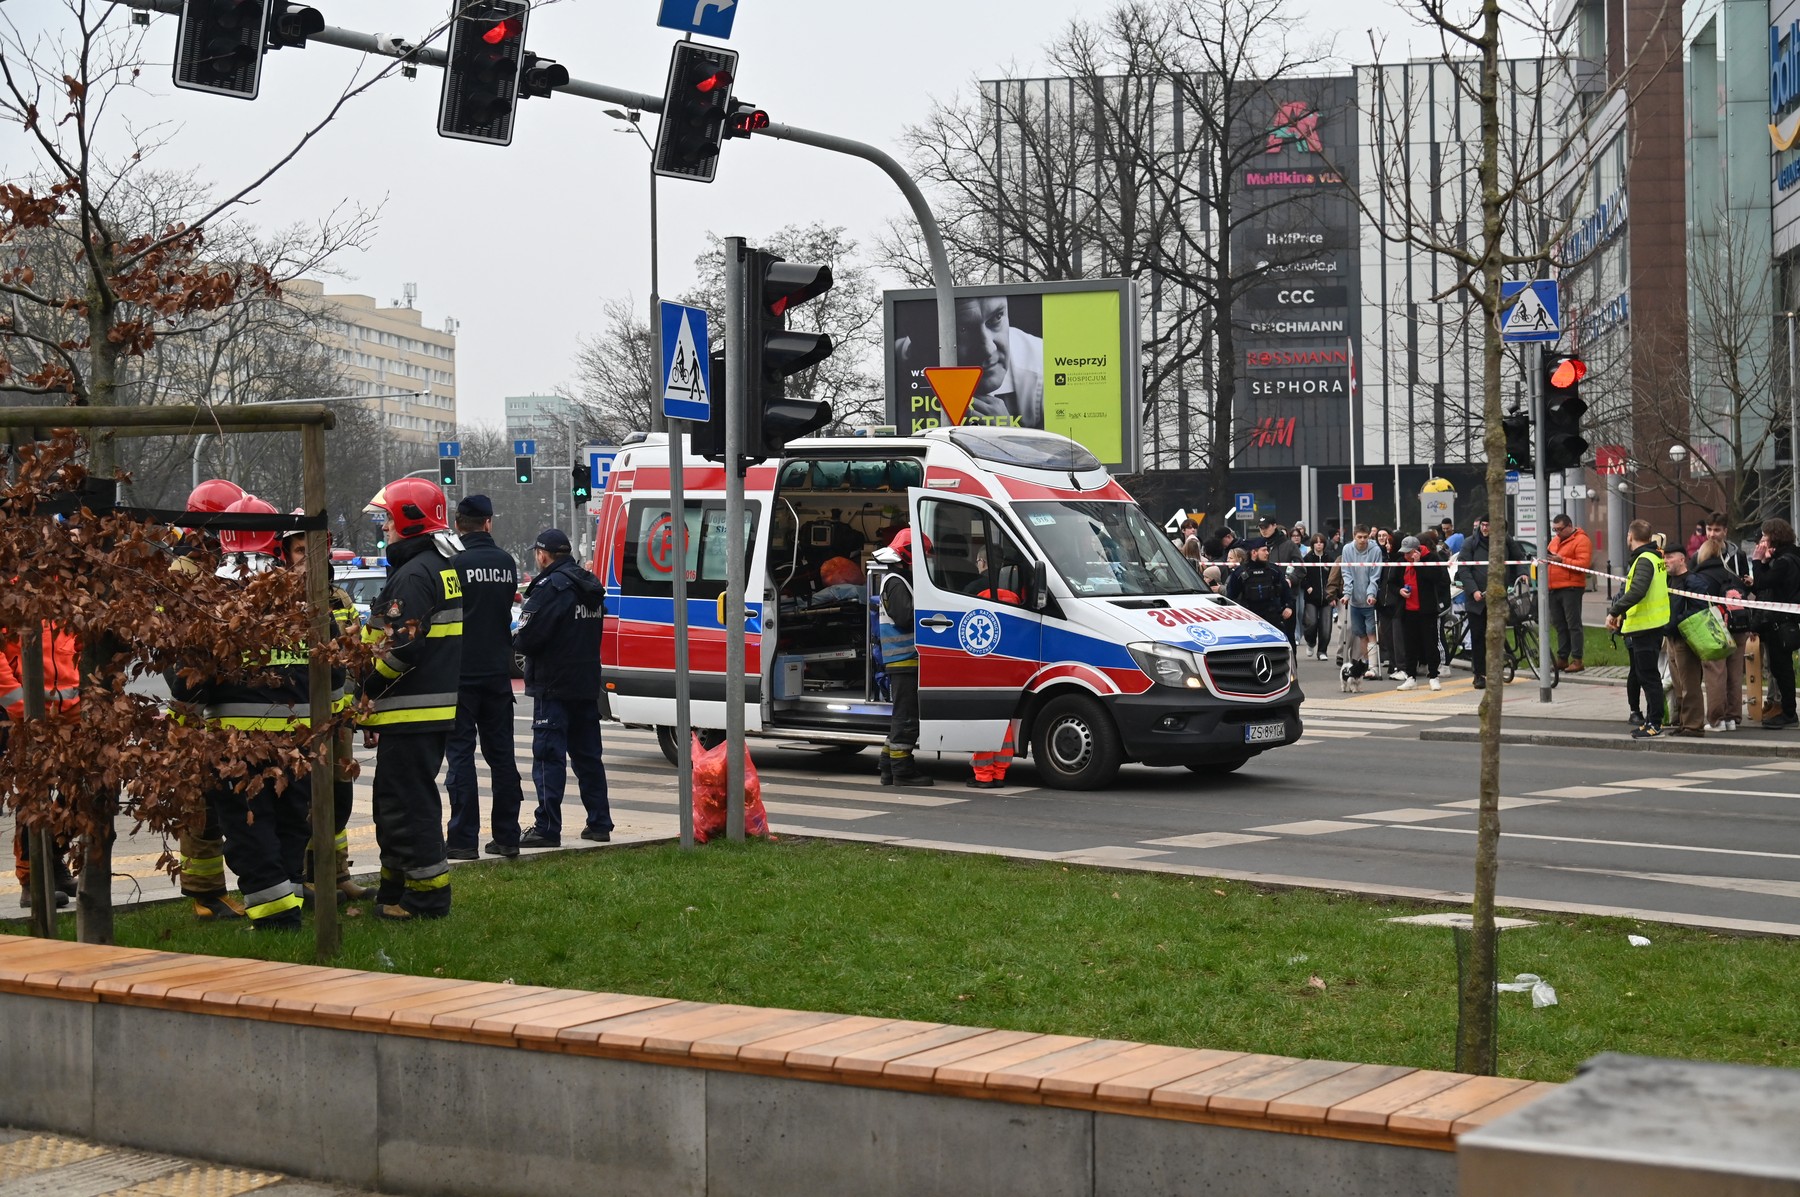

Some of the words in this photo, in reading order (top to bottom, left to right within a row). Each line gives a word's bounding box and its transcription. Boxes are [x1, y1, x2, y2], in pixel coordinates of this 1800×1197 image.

[1247, 172, 1314, 185] Multikino
[1267, 233, 1323, 245] HalfPrice
[1277, 289, 1315, 304] CCC
[1054, 354, 1107, 367] Wesprzyj
[1248, 350, 1347, 366] ROSSMANN
[1253, 379, 1343, 394] SEPHORA
[1250, 416, 1297, 448] H&M
[1240, 496, 1250, 510] P
[466, 568, 513, 584] POLICJA
[1251, 726, 1263, 739] ZS
